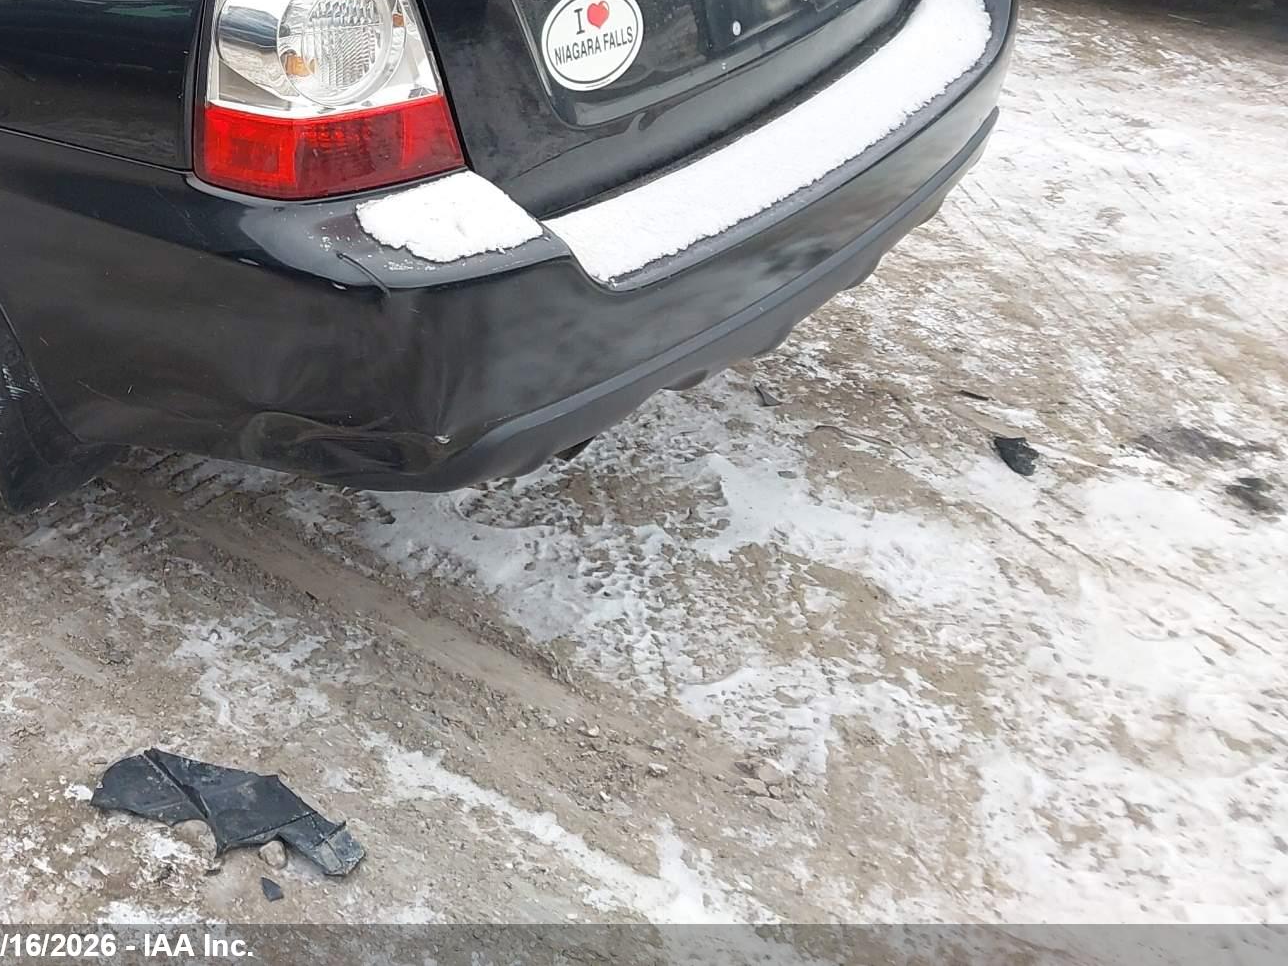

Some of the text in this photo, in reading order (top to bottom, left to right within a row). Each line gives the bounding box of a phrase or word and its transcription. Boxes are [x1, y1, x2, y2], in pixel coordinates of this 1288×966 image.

[574, 7, 585, 35] I
[554, 26, 634, 66] NIAGARA FALLS
